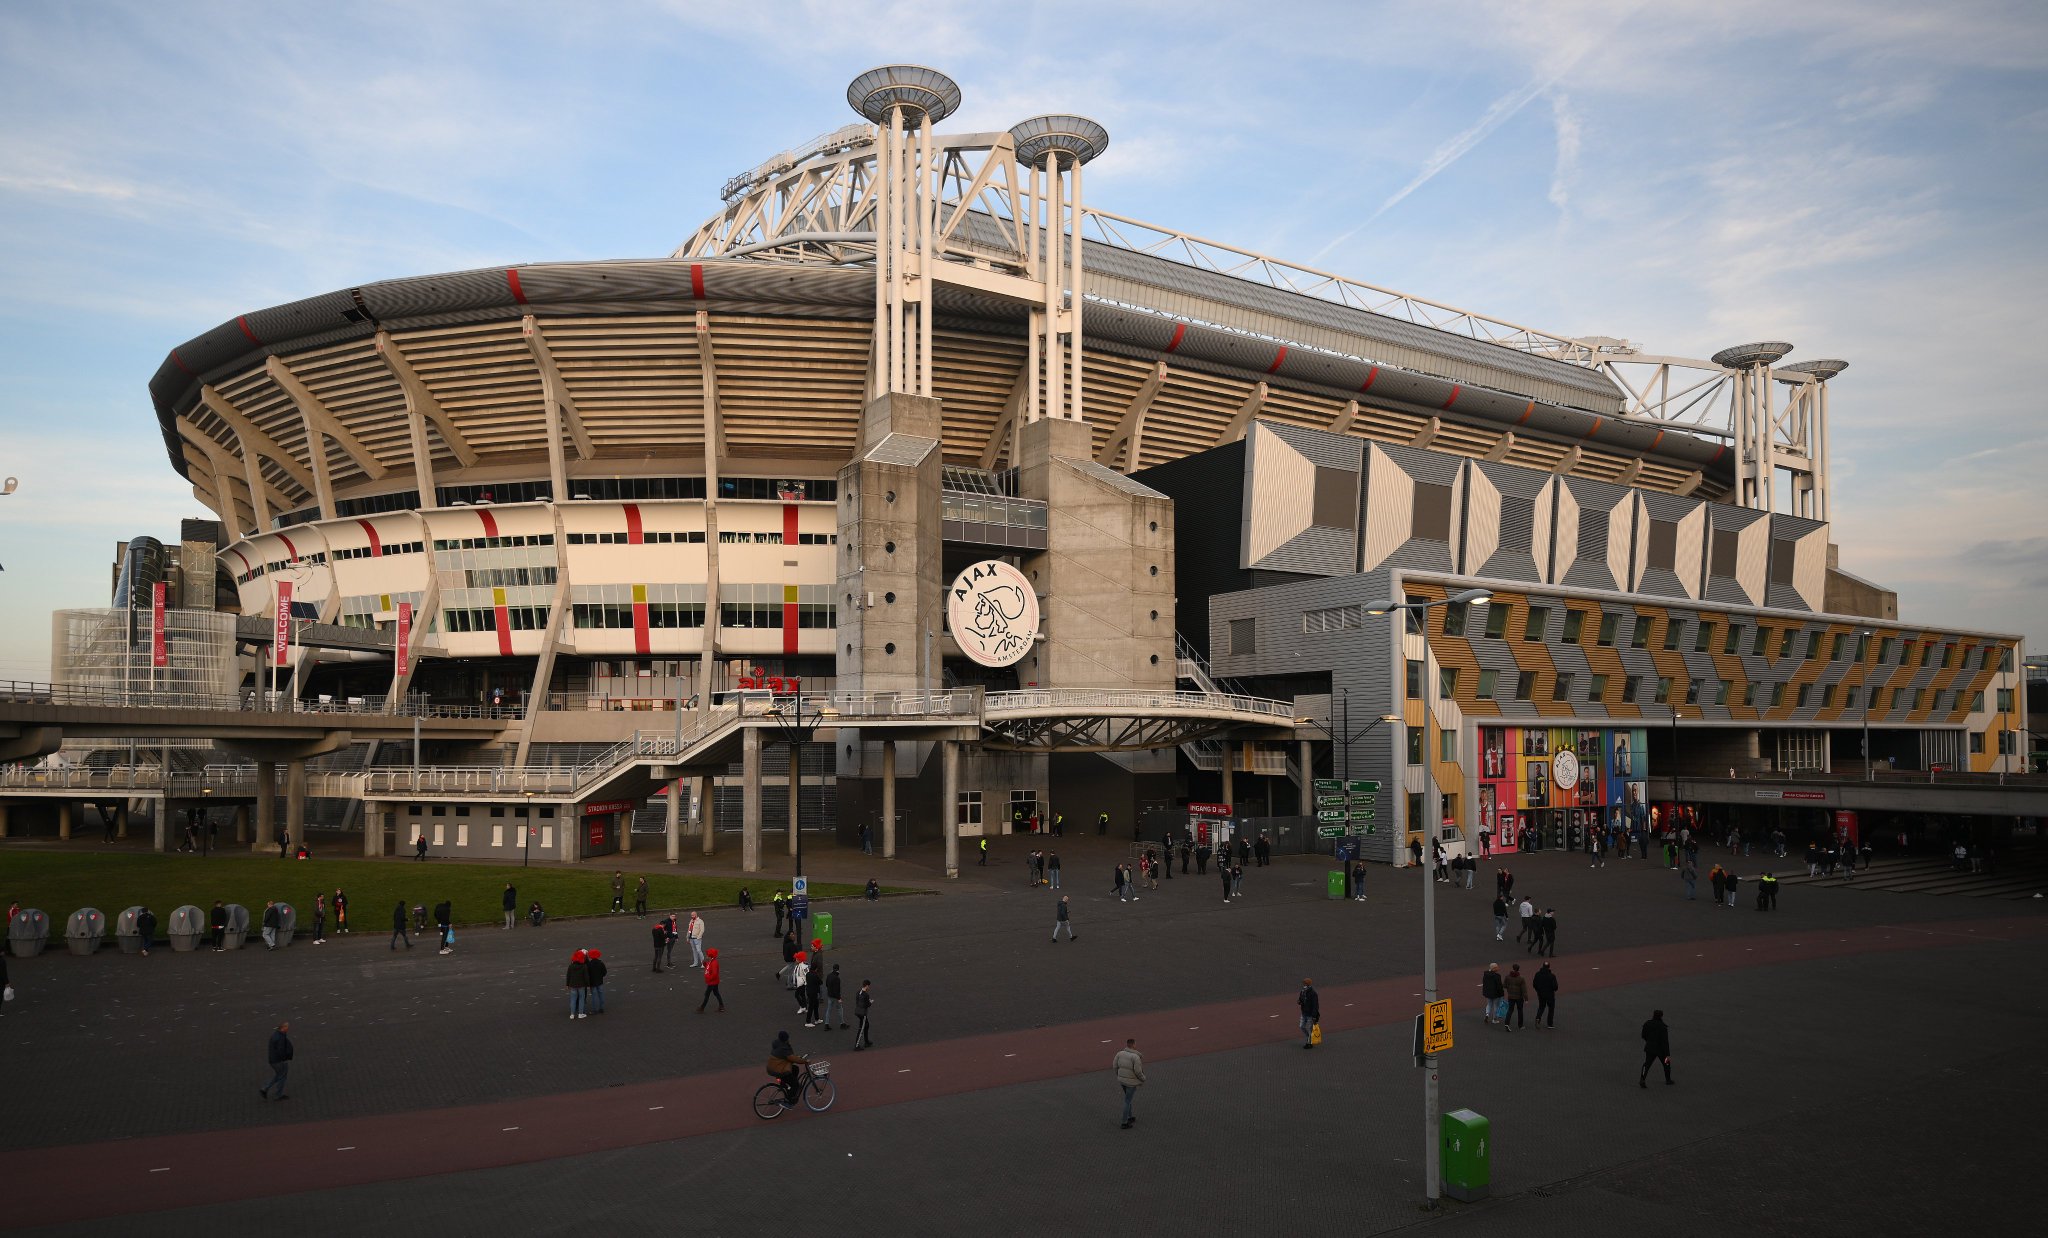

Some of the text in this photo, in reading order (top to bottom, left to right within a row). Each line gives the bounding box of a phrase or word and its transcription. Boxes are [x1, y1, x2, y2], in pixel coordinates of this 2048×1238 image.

[954, 564, 998, 603] AJAX
[278, 595, 290, 652] WELCOME
[997, 630, 1034, 662] AMSTERDAM
[1432, 1005, 1446, 1014] TAXI
